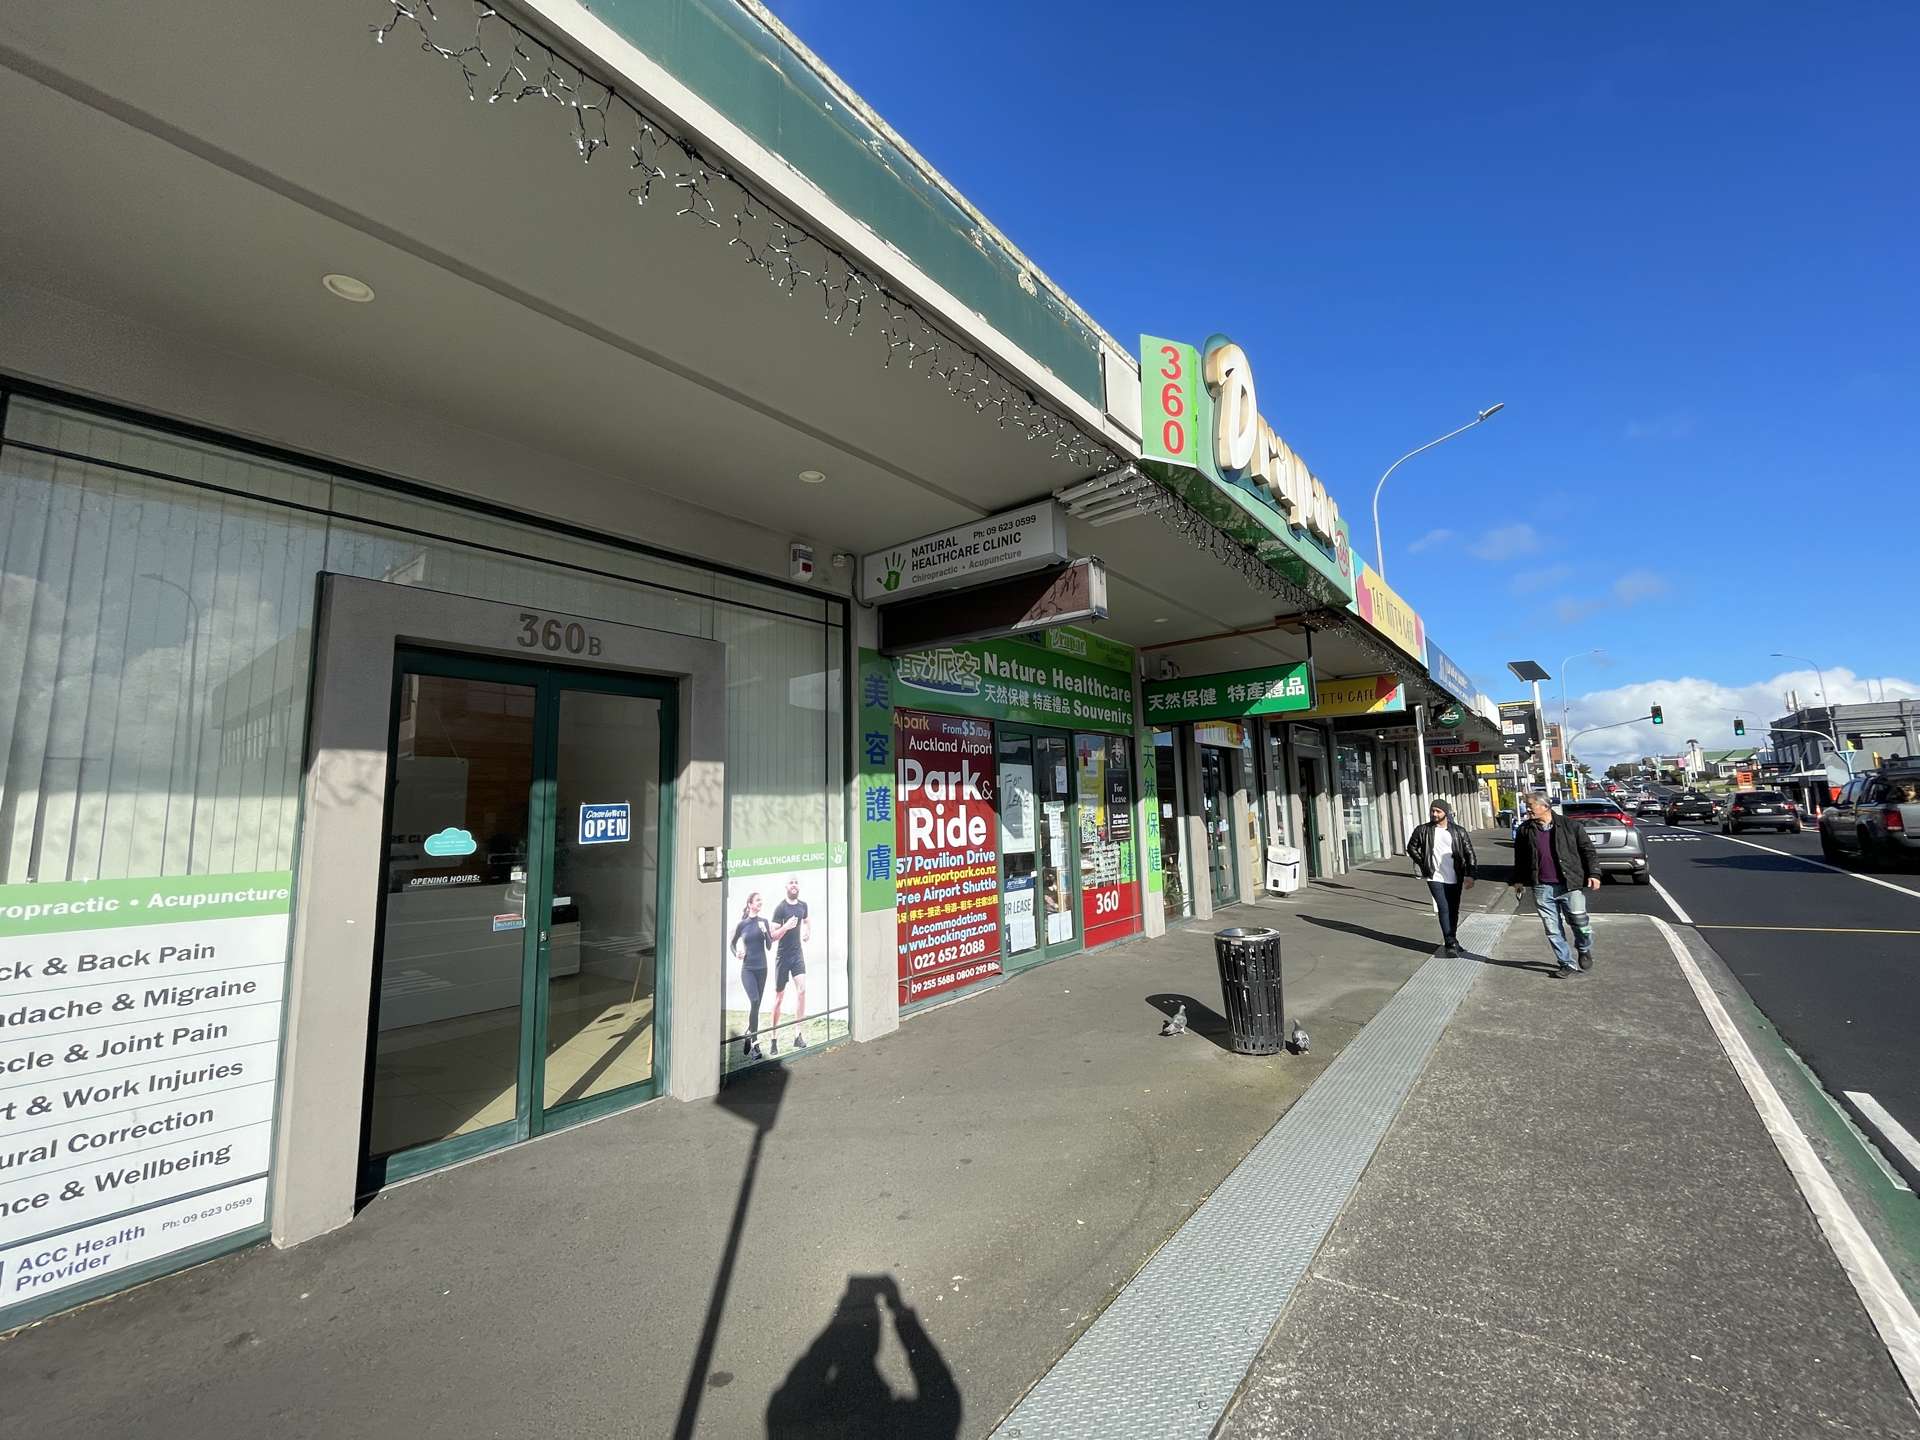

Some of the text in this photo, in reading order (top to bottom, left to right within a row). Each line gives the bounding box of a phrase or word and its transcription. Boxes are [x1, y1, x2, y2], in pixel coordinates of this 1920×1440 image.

[1161, 345, 1184, 456] 360
[911, 514, 1037, 558] NATURAL Ph: 09 623 0599
[911, 532, 1022, 571] HEALTHCARE CLINIC
[912, 550, 1022, 583] Chiropractic Acupuncture
[984, 651, 1132, 703] Nature Healthcare
[984, 684, 1030, 708] 天然保健
[1148, 676, 1305, 712] 天然保健 特產禮品
[1073, 699, 1133, 725] Souvenirs
[942, 723, 961, 735] From
[908, 735, 992, 756] Auckland Airport
[897, 758, 993, 802] Park &
[1113, 783, 1123, 793] For
[584, 818, 627, 838] OPEN
[908, 803, 987, 851] Ride
[753, 854, 801, 866] HEALTHCARE
[802, 852, 825, 861] CLINIC
[914, 852, 964, 872] Pavilion
[966, 847, 996, 865] Drive
[410, 874, 481, 886] OPENING HOURS:
[896, 865, 996, 890] www.airportpark.co.nz
[896, 892, 921, 906] Free
[922, 885, 961, 902] Airport
[962, 877, 997, 894] Shuttle
[147, 886, 290, 909] Acupuncture
[1013, 898, 1032, 914] LEASE
[1095, 890, 1119, 915] 360
[911, 911, 988, 937] Accommodations
[42, 958, 68, 976] &
[77, 949, 151, 973] Back
[158, 943, 216, 964] Pain
[913, 938, 986, 970] 022 652 2088
[112, 993, 136, 1011] &
[143, 979, 257, 1007] Migraine
[911, 983, 923, 994] 09
[922, 979, 937, 991] 255
[956, 969, 976, 980] 0800
[63, 1043, 89, 1063] &
[97, 1032, 164, 1060] Joint
[172, 1023, 228, 1045] Pain
[26, 1095, 53, 1115] &
[62, 1079, 140, 1110] Work
[148, 1061, 244, 1093] Injuries
[67, 1106, 214, 1151] Correction
[59, 1180, 85, 1201] &
[94, 1143, 233, 1192] Wellbeing
[17, 1196, 254, 1274] ACC Health Ph: 09 623 0599
[16, 1252, 111, 1291] Provider
